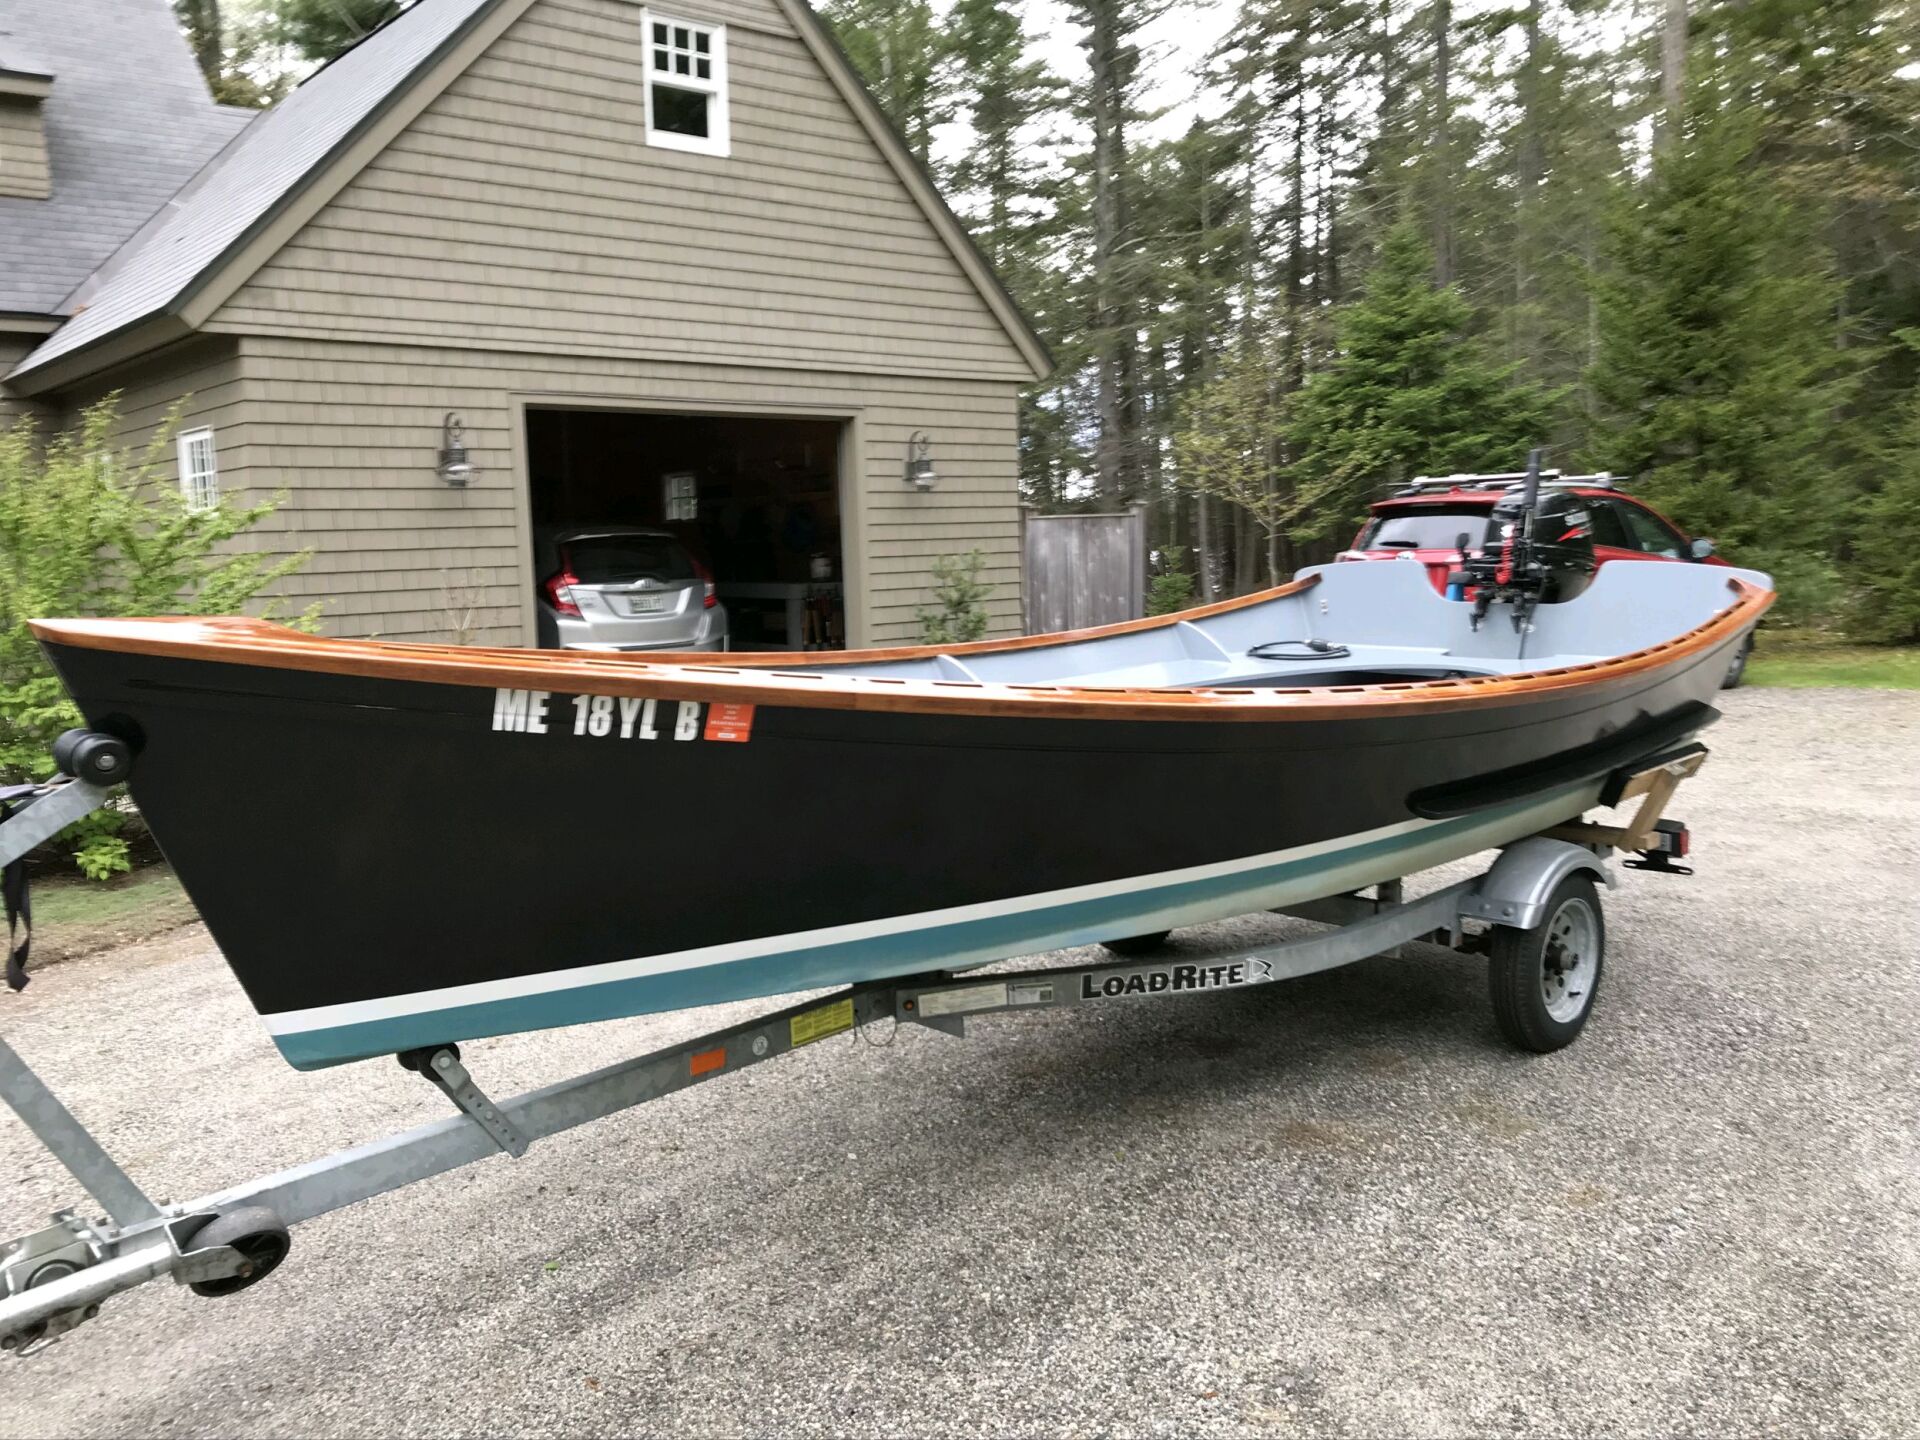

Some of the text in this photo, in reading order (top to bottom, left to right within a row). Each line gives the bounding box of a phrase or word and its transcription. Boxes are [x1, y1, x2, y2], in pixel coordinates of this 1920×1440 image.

[492, 687, 550, 734] ME
[572, 694, 659, 740] 18YL
[674, 701, 700, 741] B
[1081, 963, 1244, 999] LOADRITE
